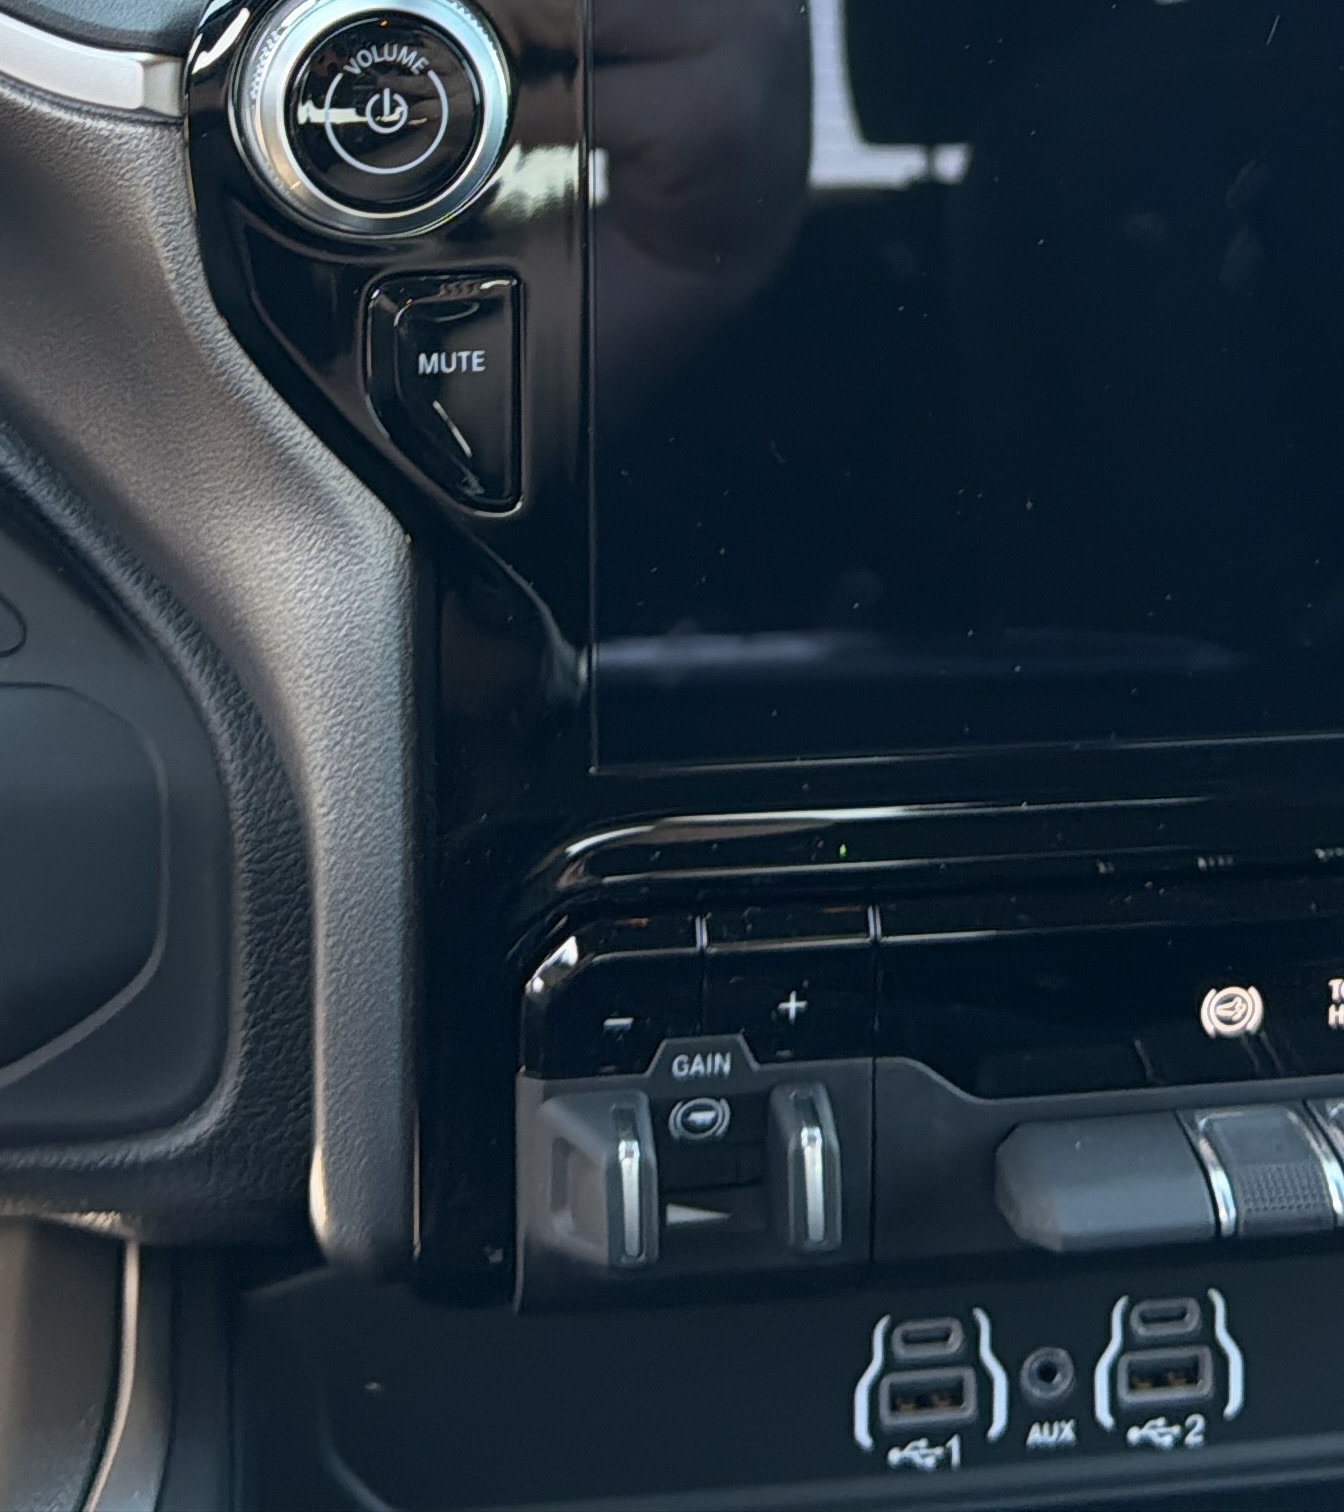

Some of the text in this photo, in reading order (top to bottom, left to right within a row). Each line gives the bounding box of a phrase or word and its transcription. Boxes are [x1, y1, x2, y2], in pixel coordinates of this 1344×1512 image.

[343, 43, 430, 76] VOLUME
[418, 349, 487, 374] MUTE
[671, 1052, 732, 1079] GAIN
[1025, 1418, 1077, 1449] AUX
[1184, 1413, 1206, 1448] 2
[945, 1434, 961, 1471] 1
